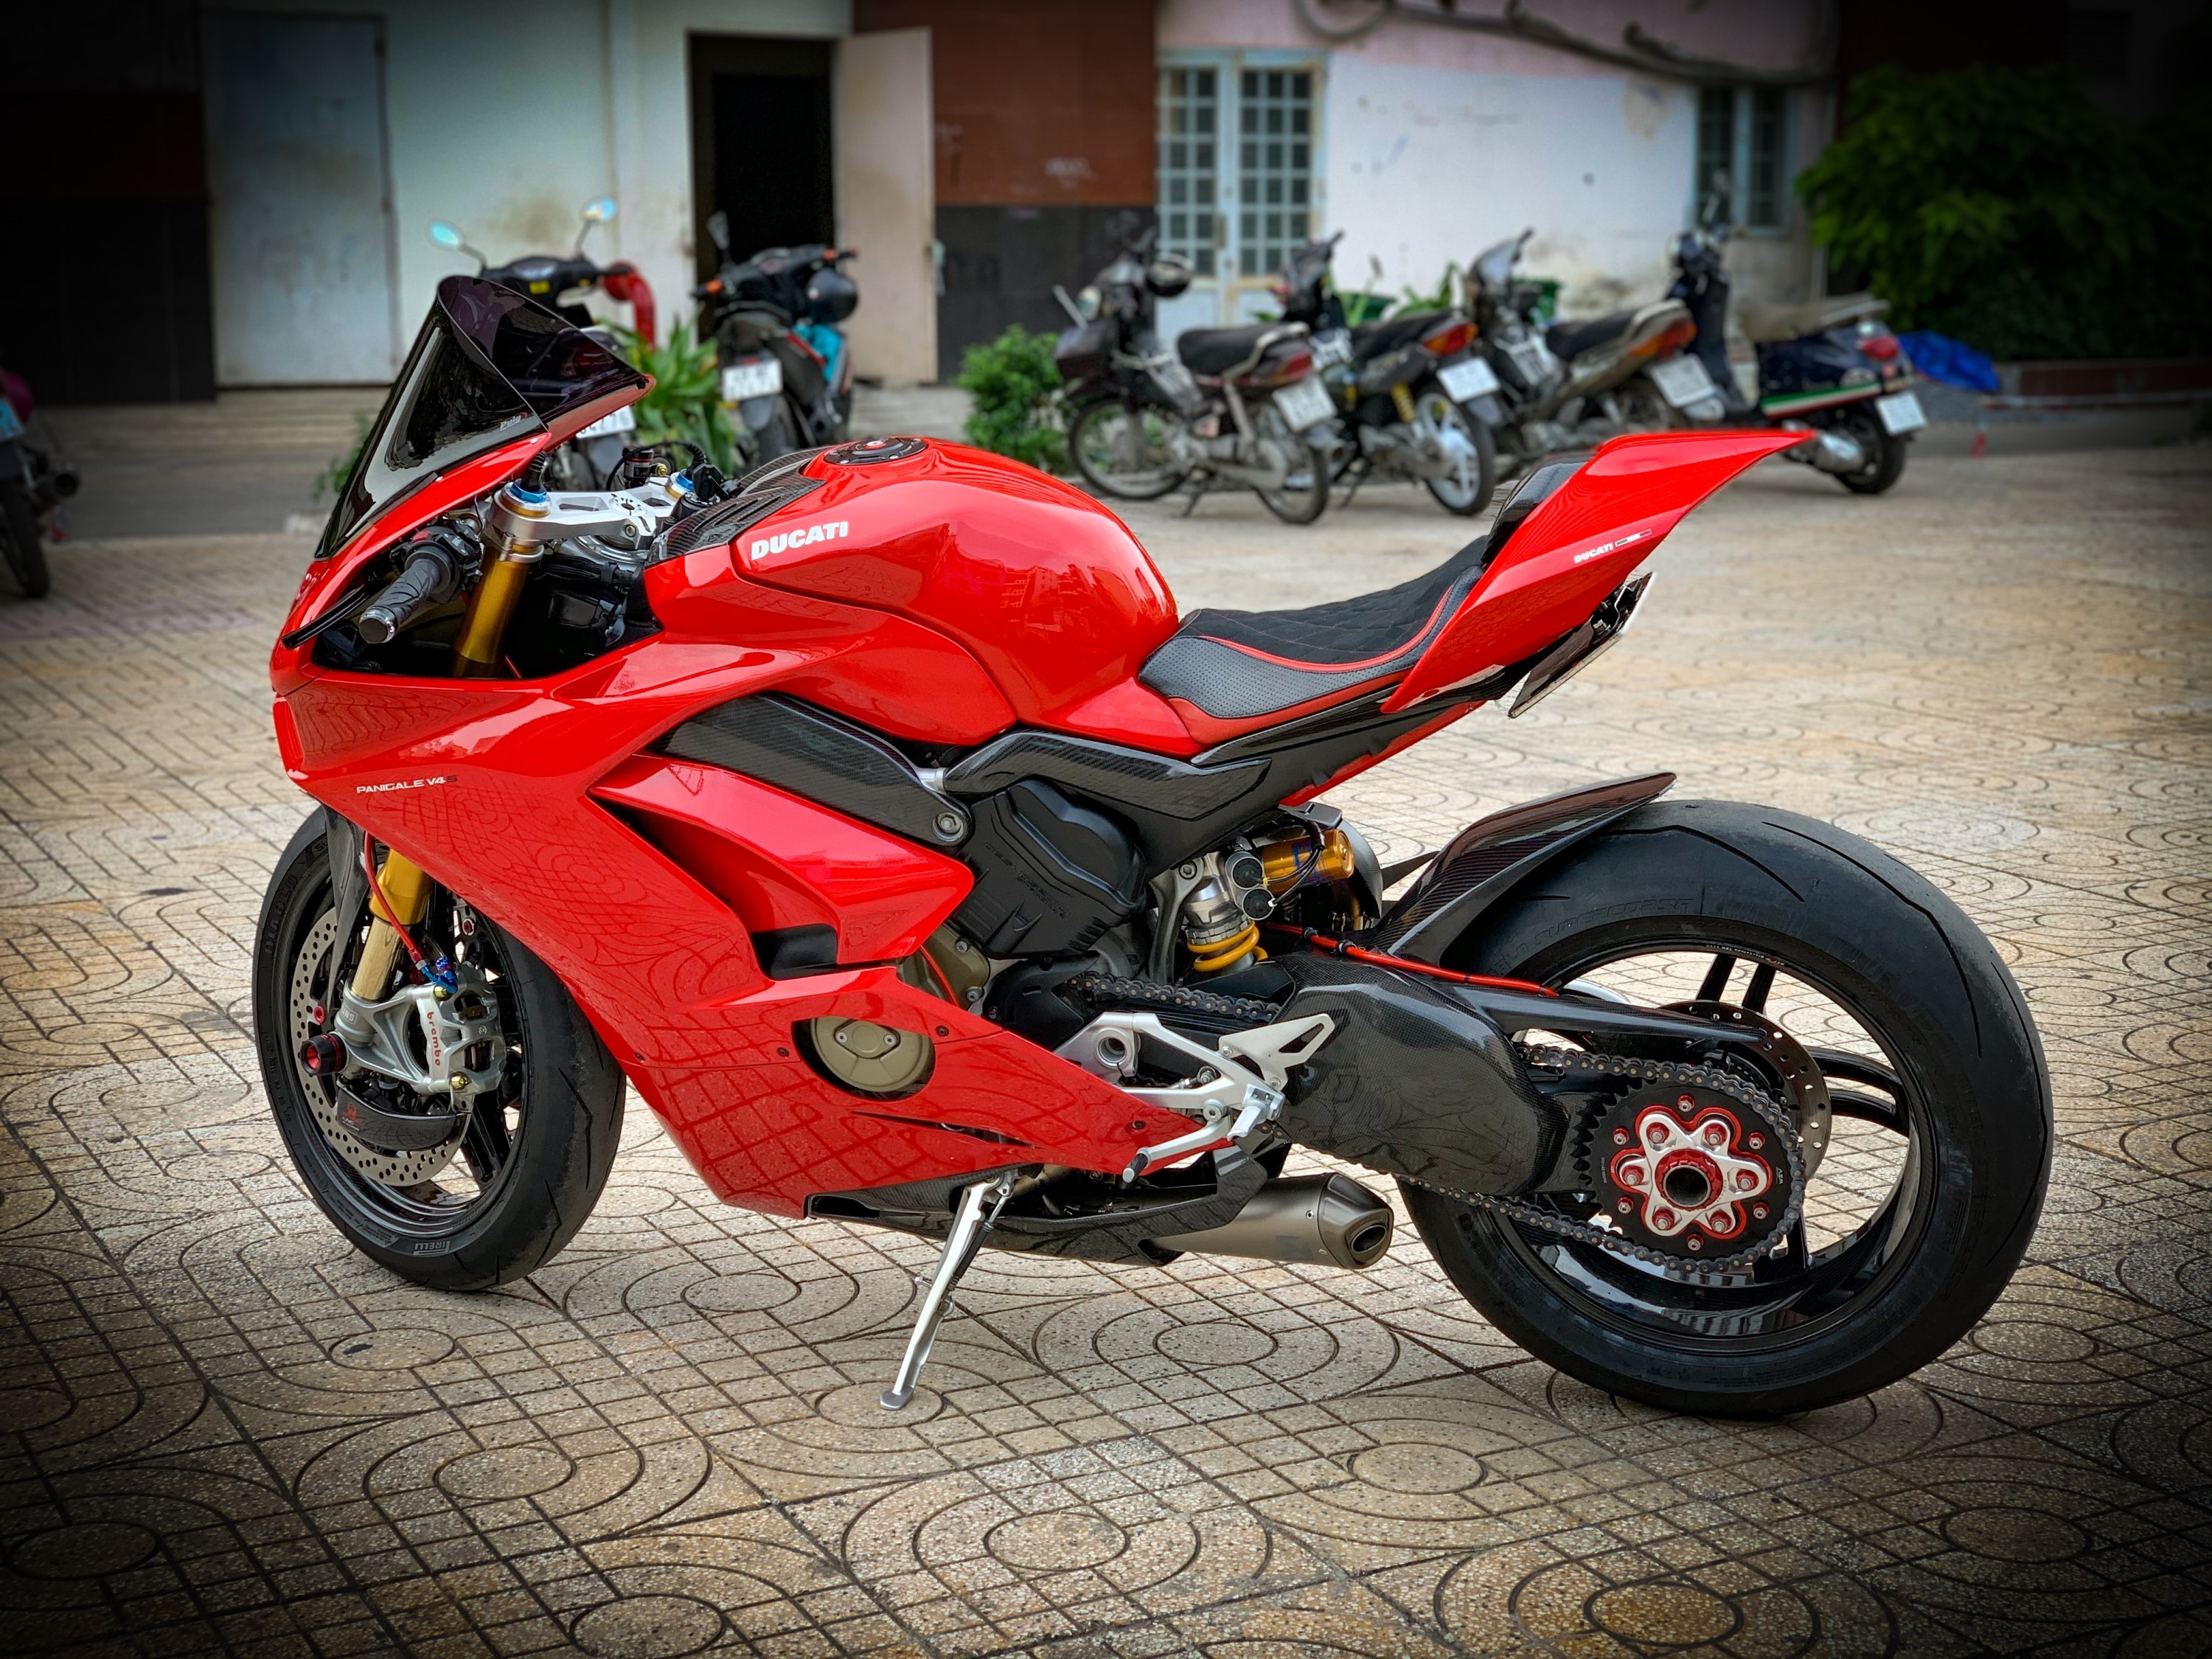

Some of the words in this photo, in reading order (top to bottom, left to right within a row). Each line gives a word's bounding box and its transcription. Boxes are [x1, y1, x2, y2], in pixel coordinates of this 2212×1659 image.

[751, 521, 849, 560] DUCATI
[1573, 542, 1614, 563] DUCATI
[356, 779, 425, 794] PANIGALE
[427, 1011, 442, 1066] brembo
[413, 1240, 451, 1256] PIRELLI
